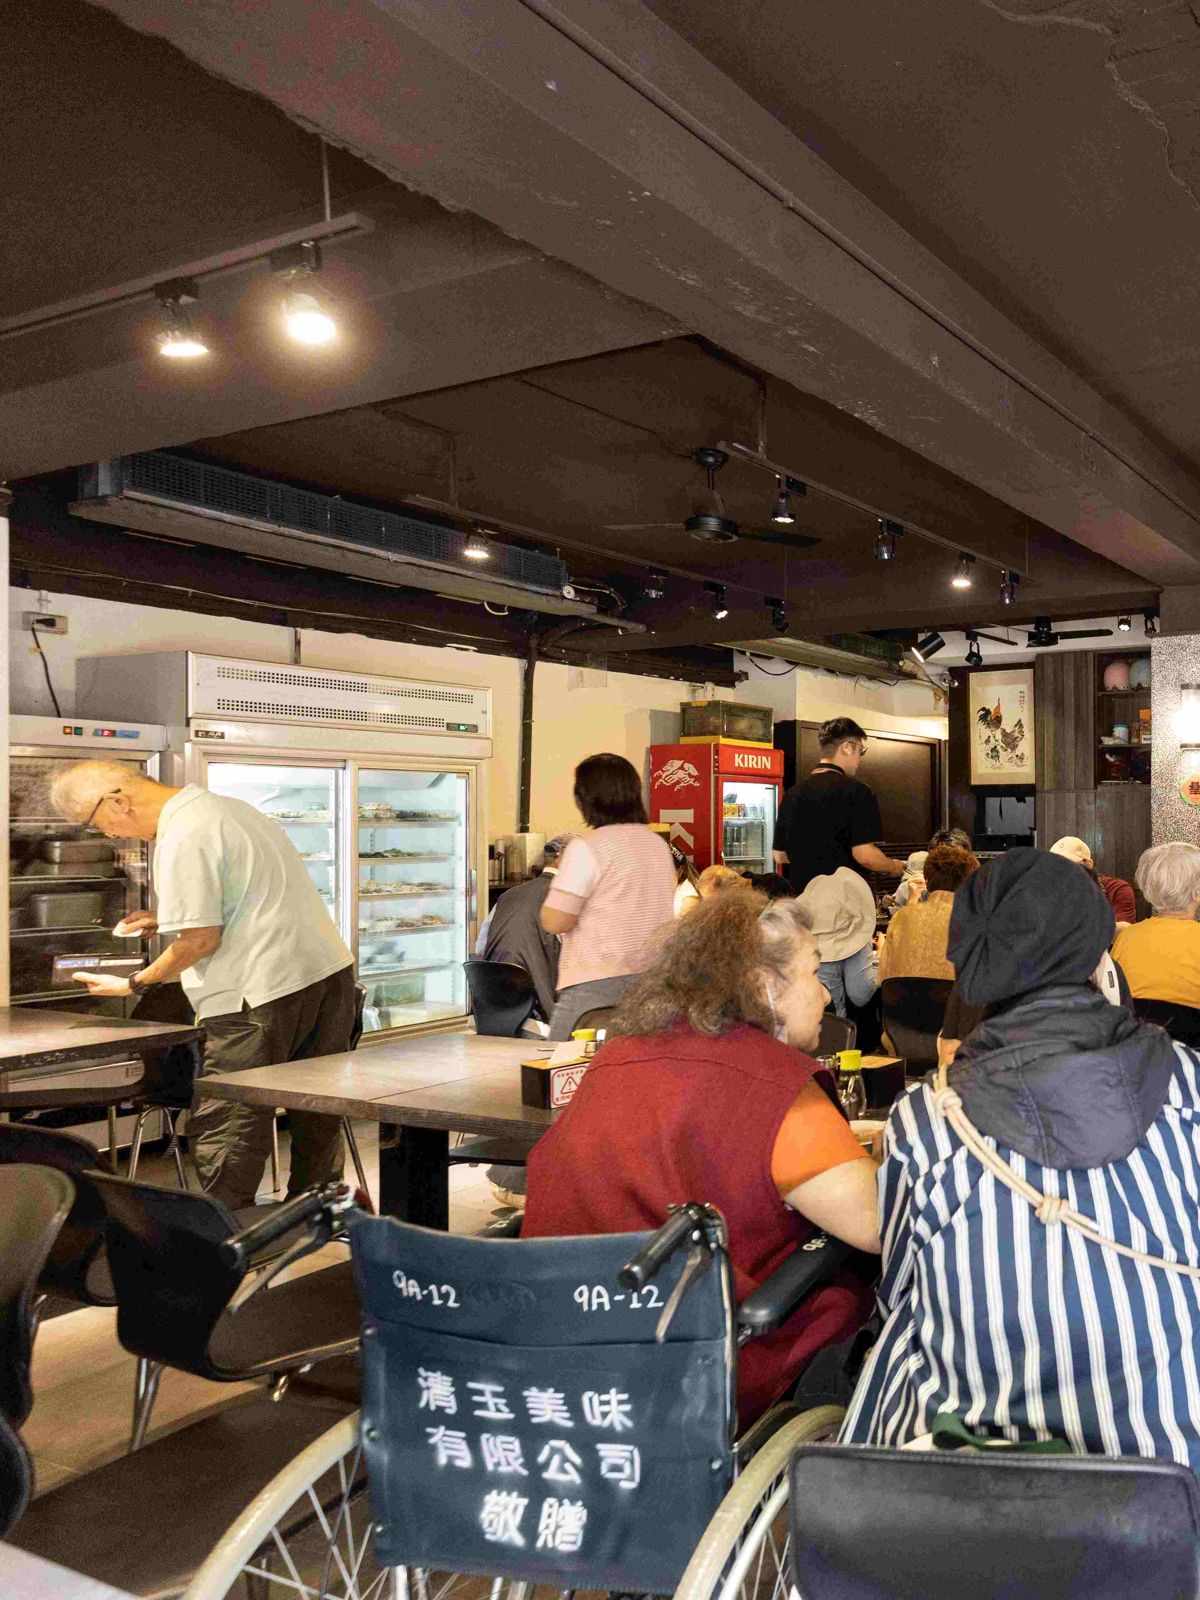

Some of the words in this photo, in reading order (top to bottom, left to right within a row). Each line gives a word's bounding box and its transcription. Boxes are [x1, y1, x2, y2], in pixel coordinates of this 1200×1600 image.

[734, 753, 771, 770] KIRIN
[392, 1270, 460, 1308] 9A-12
[573, 1284, 664, 1311] 9A-12
[417, 1367, 634, 1432] 清玉美味
[425, 1425, 641, 1489] 有限公司
[480, 1489, 588, 1551] 敬贈
